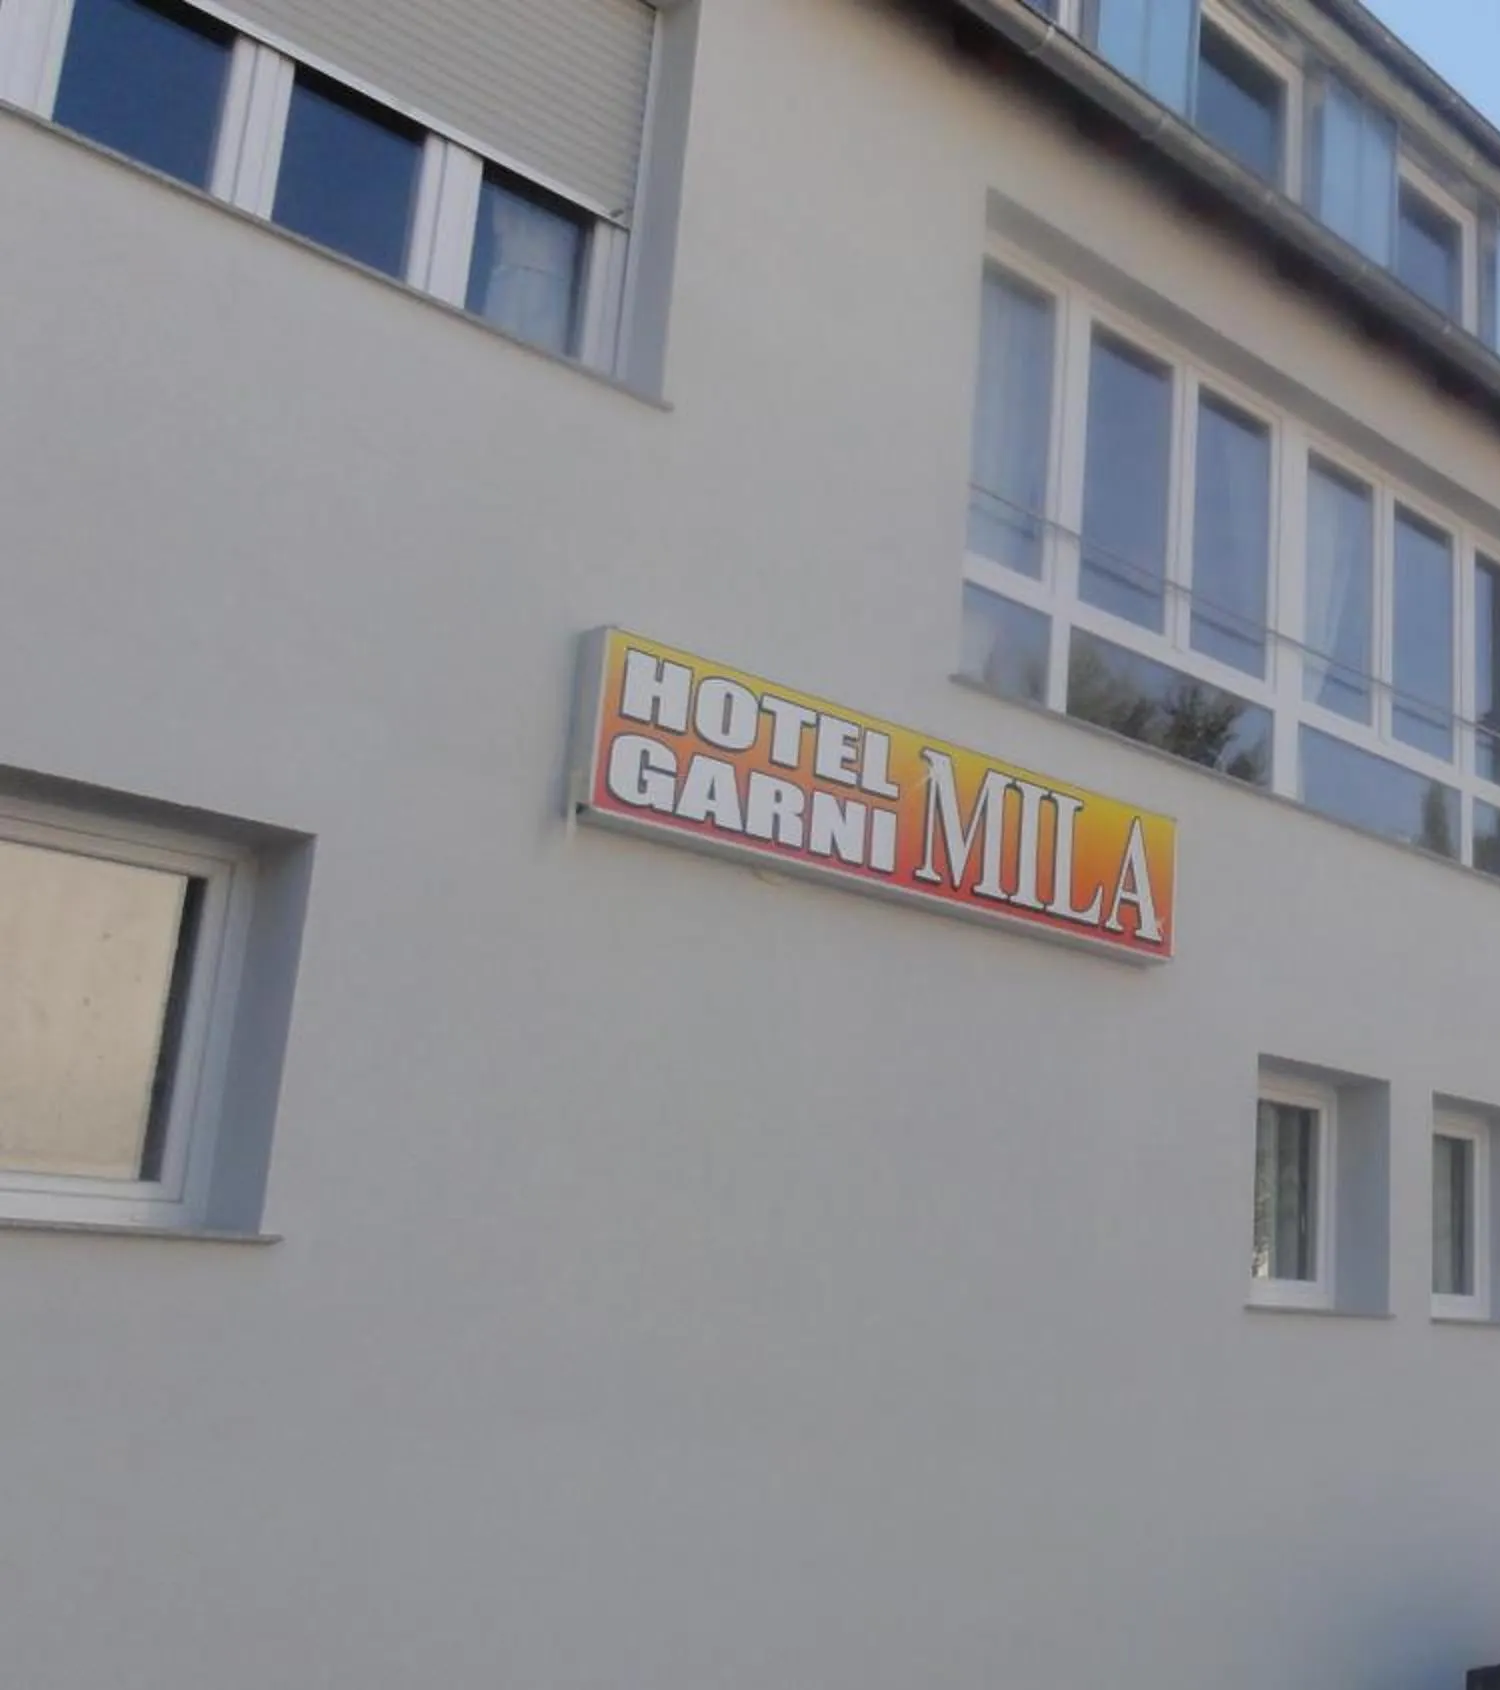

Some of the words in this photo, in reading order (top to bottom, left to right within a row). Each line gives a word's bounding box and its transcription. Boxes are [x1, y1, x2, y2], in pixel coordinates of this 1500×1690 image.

[620, 647, 900, 800] HOTEL
[607, 733, 898, 873] GARNI
[913, 747, 1163, 944] MILA
